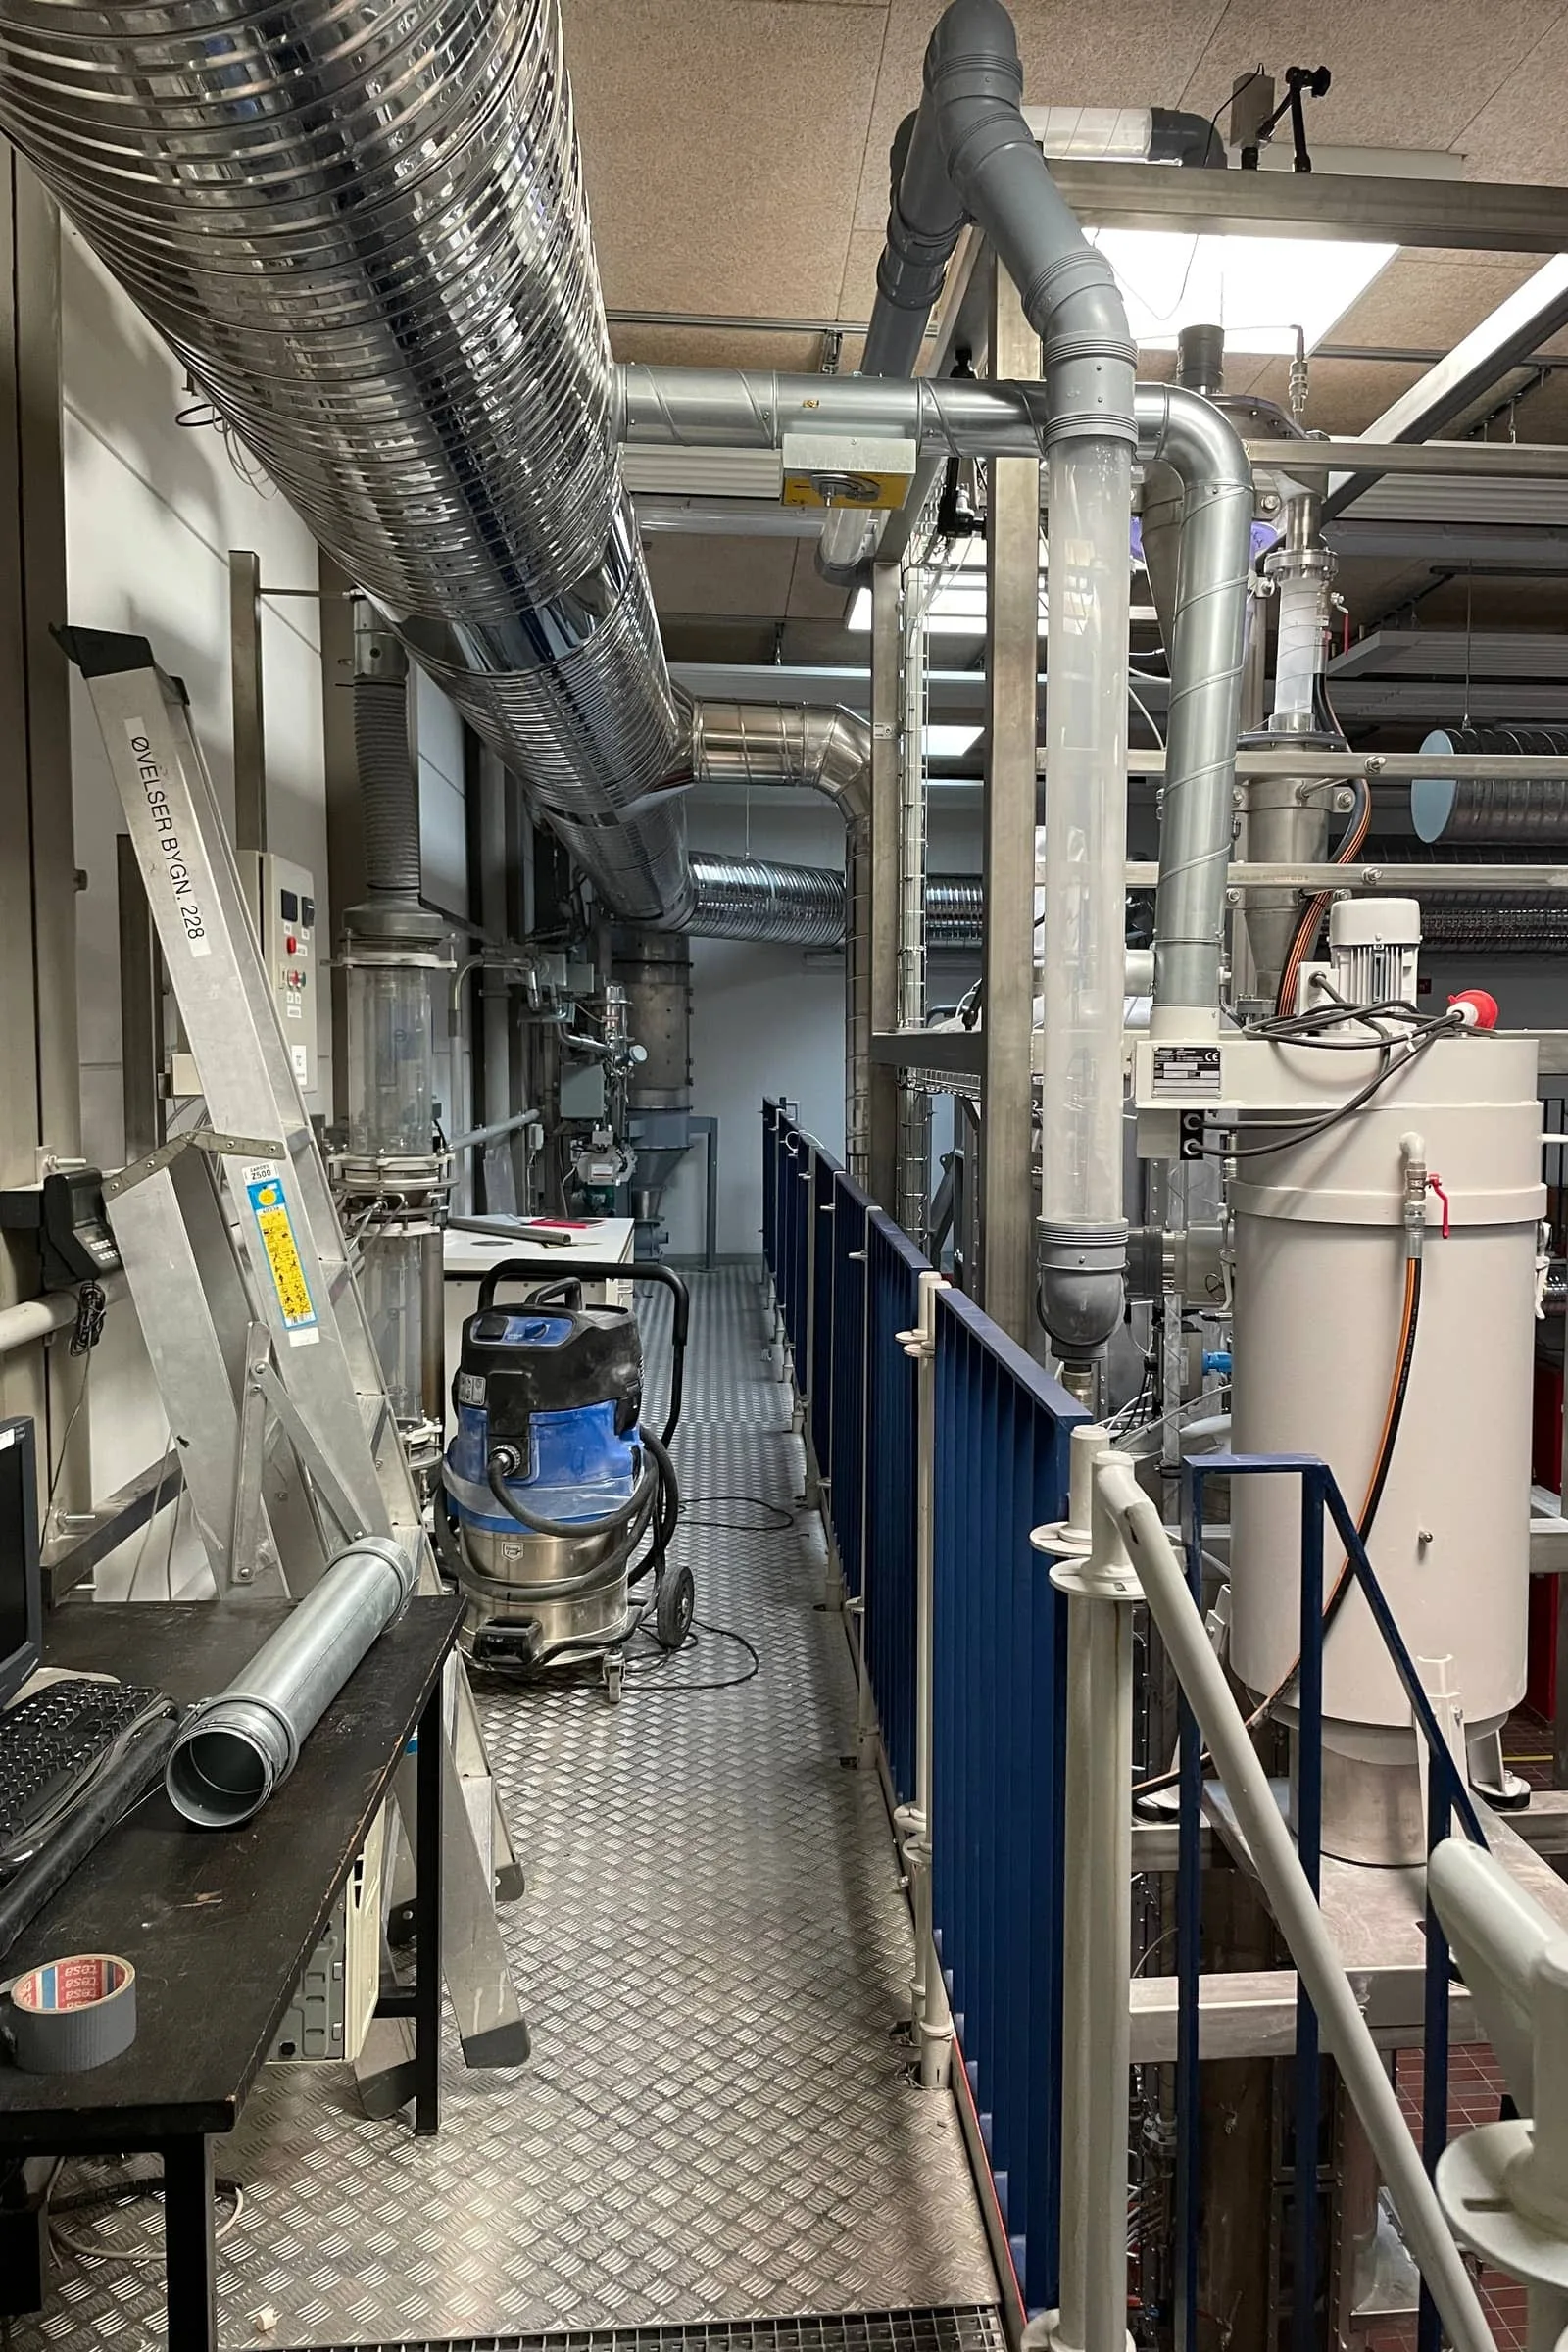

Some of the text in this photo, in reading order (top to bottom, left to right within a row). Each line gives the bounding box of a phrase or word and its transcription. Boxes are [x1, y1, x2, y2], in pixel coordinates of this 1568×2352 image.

[131, 736, 205, 940] ØVELSER BYGN. 228
[64, 1964, 97, 1977] tesa
[65, 1977, 97, 1988] tesa
[65, 1988, 97, 2001] tesa
